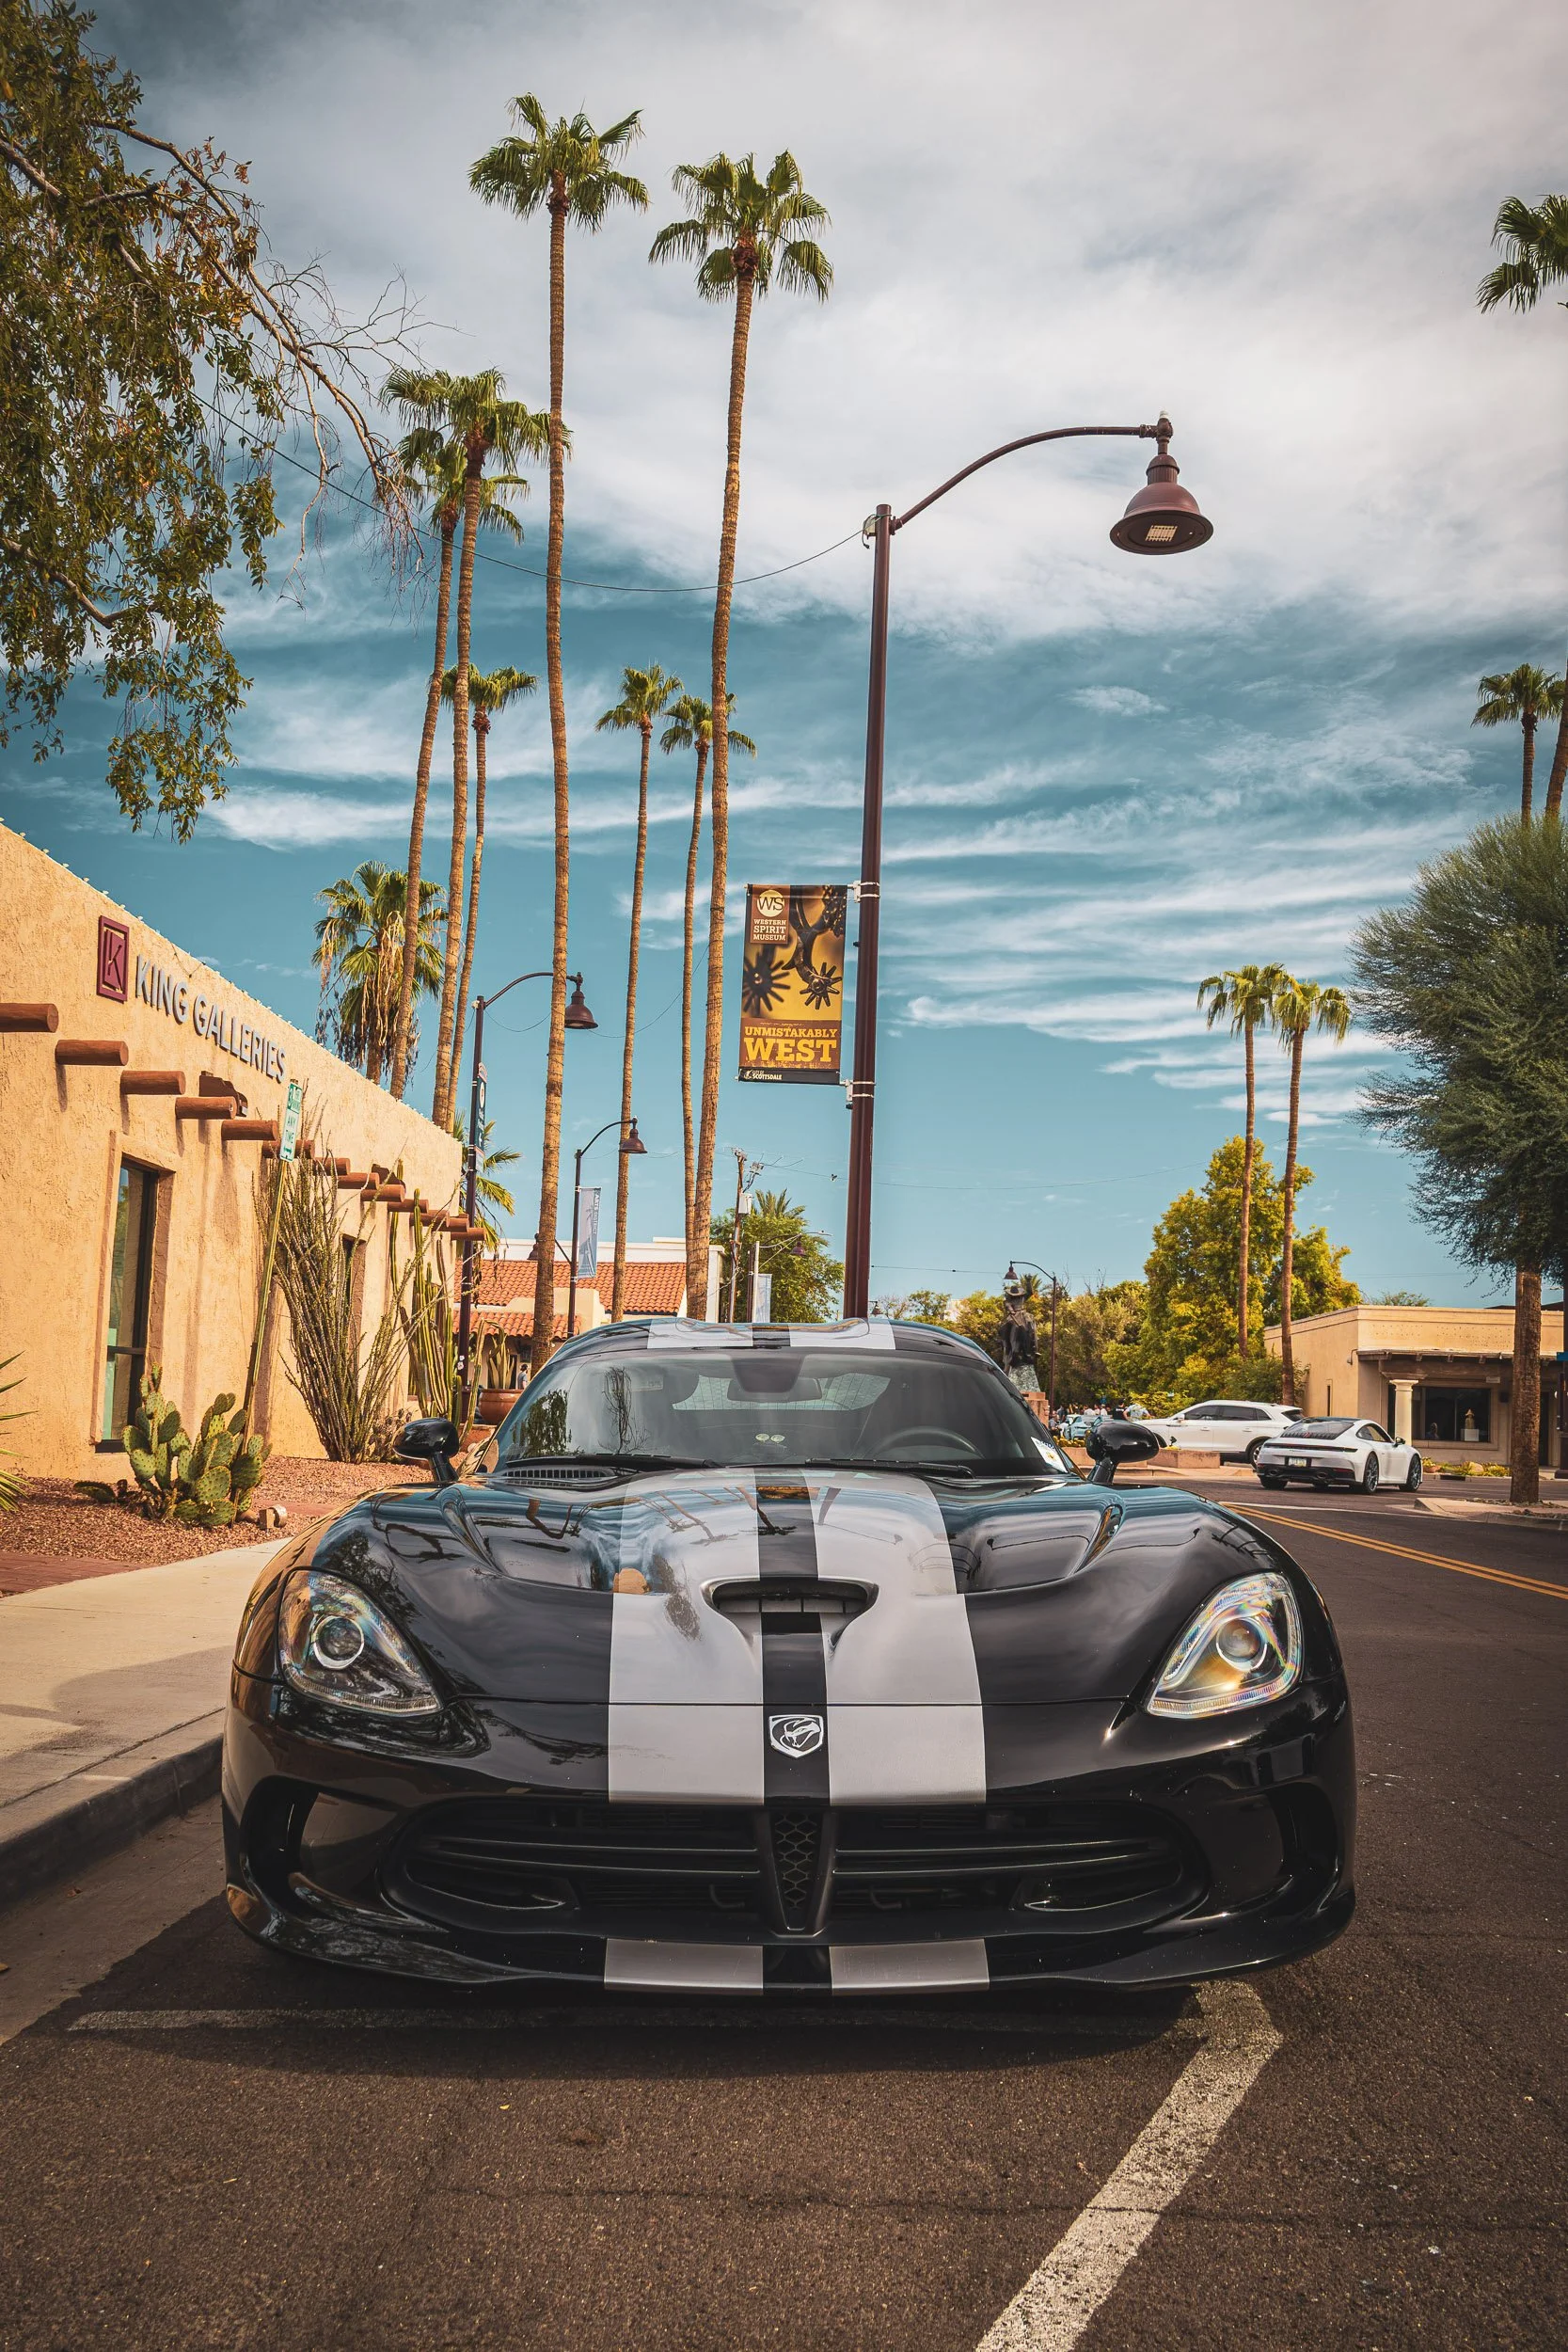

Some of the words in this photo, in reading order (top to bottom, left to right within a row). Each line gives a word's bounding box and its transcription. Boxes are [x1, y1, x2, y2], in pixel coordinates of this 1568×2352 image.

[758, 897, 784, 911] WS
[753, 925, 786, 934] SPIRIT
[135, 954, 188, 1025] KING
[194, 993, 287, 1084] GALLERIES
[744, 1025, 838, 1038] UNMISTAKABLY
[743, 1037, 836, 1062] WEST
